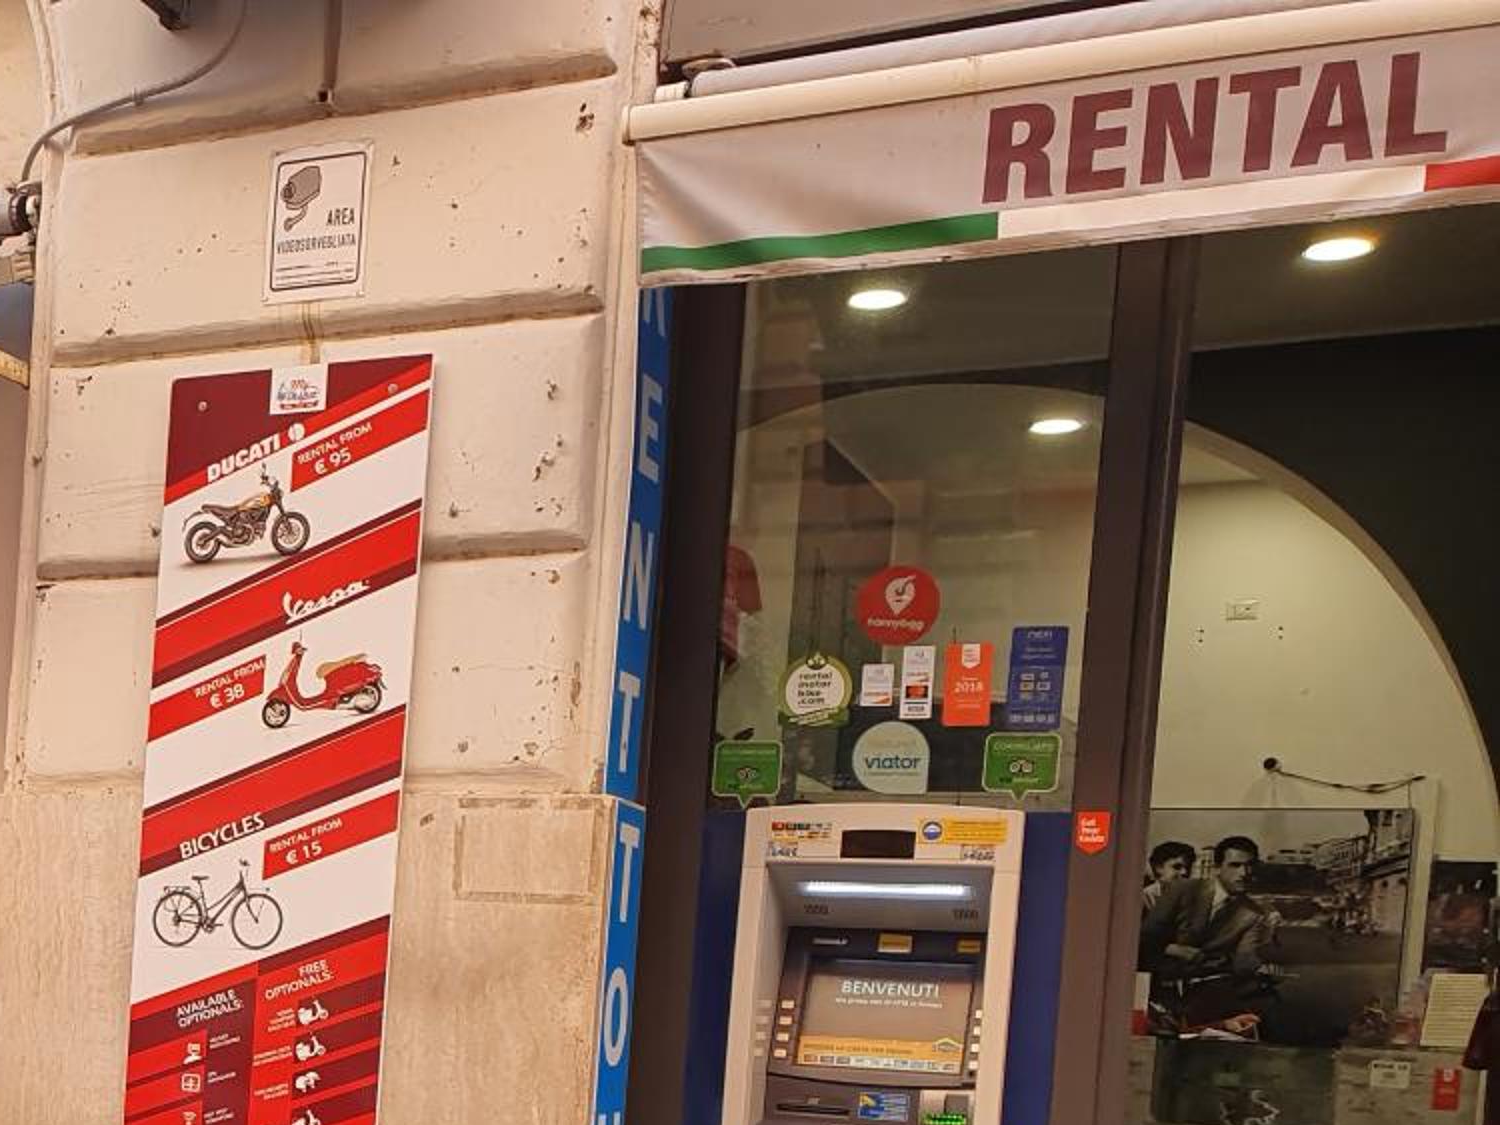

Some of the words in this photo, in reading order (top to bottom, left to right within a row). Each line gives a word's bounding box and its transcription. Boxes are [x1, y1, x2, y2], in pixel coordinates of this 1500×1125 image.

[982, 52, 1447, 203] RENTAL
[326, 207, 356, 227] AREA
[297, 438, 339, 465] RENTAL
[339, 422, 373, 446] FROM
[330, 447, 352, 469] 95
[206, 434, 281, 484] DUCATI
[282, 580, 370, 624] Vespa
[195, 675, 232, 699] RENTAL
[233, 660, 265, 684] FROM
[223, 683, 245, 704] 38
[864, 754, 921, 769] viator
[178, 811, 266, 860] BICYCLES
[269, 831, 309, 853] RENTAL
[310, 817, 343, 840] FROM
[302, 840, 322, 858] 15
[299, 959, 327, 978] FREE
[841, 981, 939, 998] BENVENUTI
